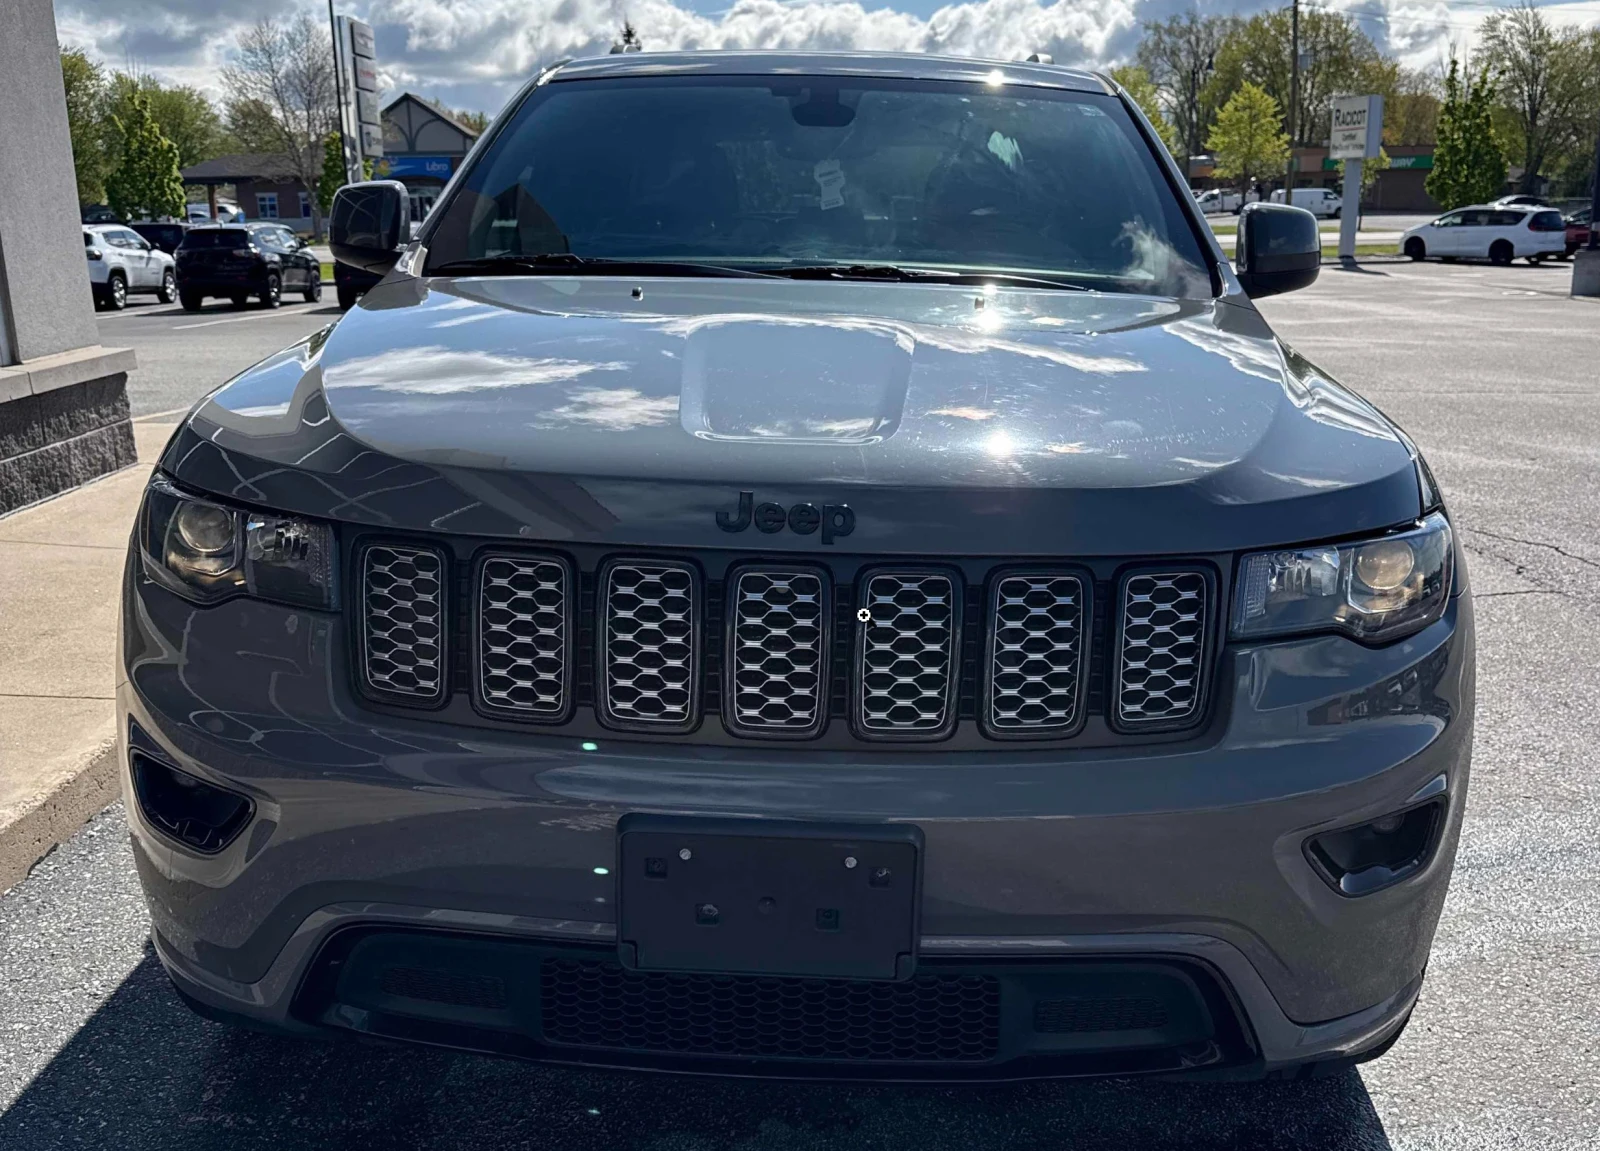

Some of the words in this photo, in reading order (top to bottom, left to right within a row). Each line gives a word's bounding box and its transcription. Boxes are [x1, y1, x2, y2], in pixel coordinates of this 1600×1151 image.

[1334, 108, 1367, 127] RACICOT
[425, 161, 449, 172] Libro
[715, 490, 857, 546] Jeep
